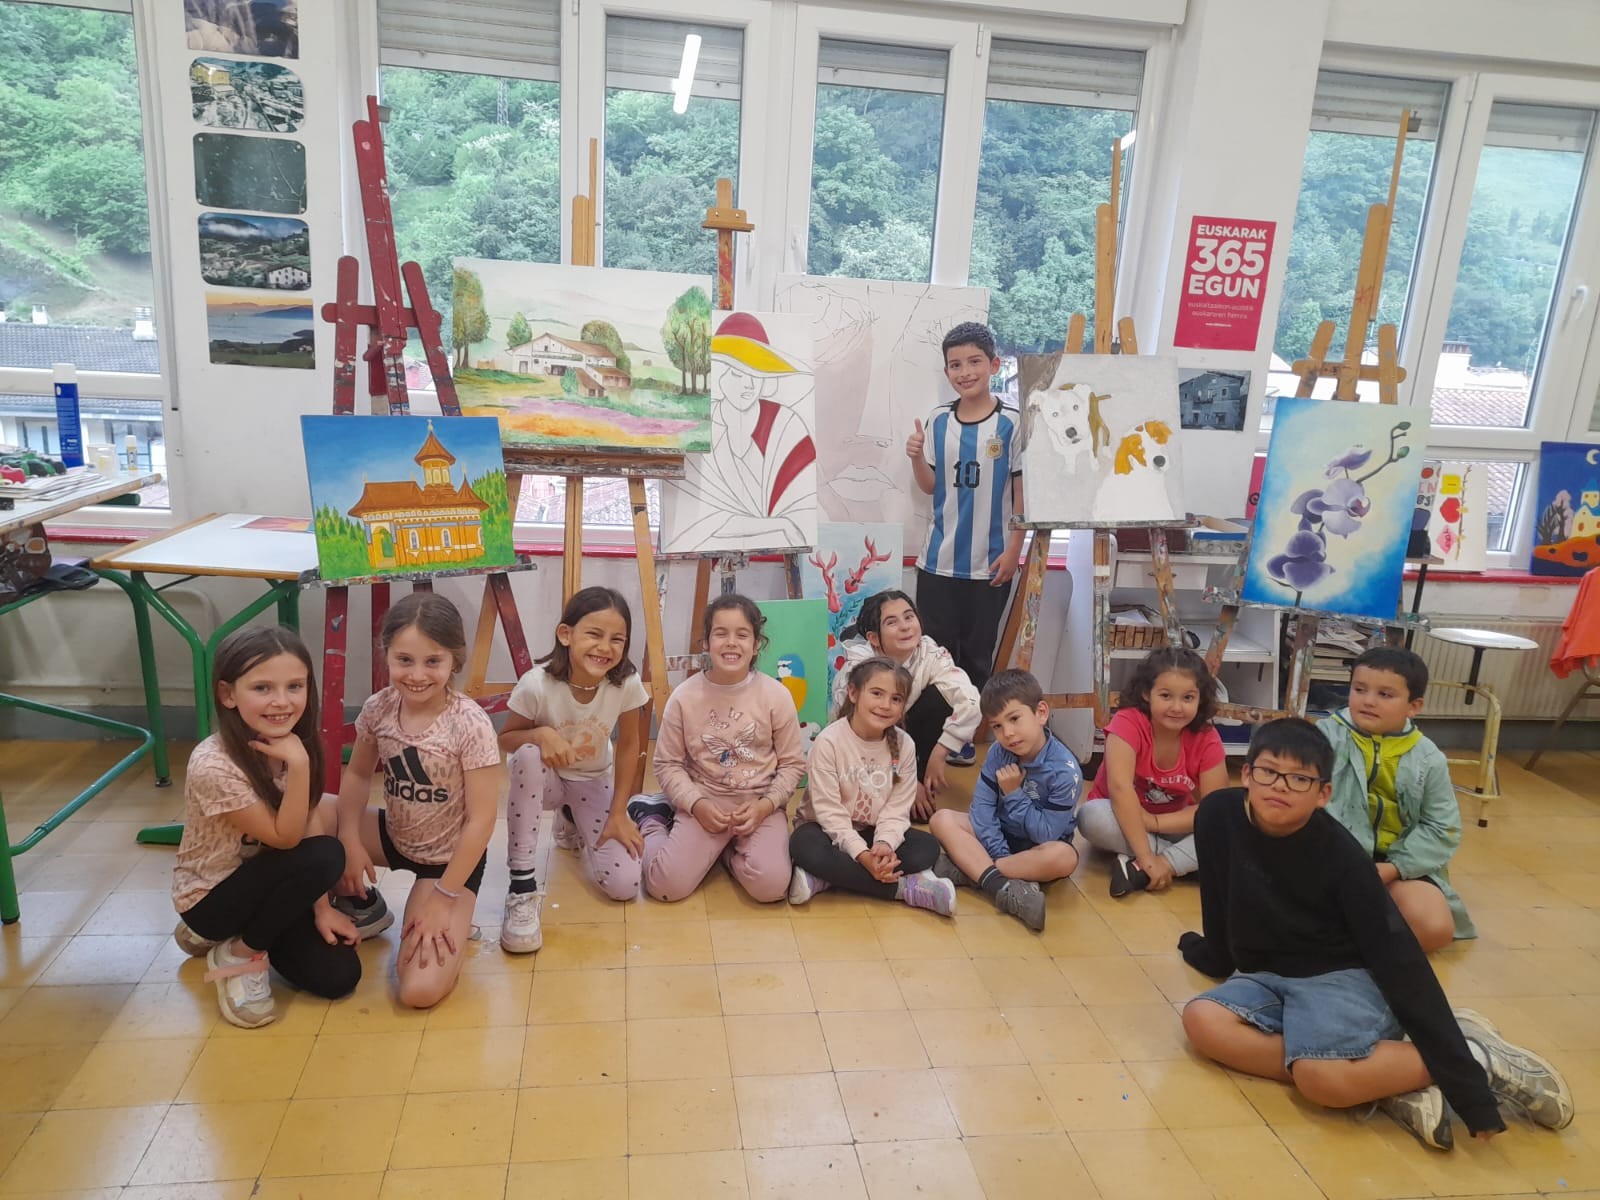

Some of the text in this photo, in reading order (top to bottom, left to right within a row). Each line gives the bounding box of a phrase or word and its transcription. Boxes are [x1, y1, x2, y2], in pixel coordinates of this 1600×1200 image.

[1197, 224, 1267, 239] EUSKARAK
[1191, 238, 1266, 276] 365
[1188, 274, 1260, 299] EGUN
[953, 461, 980, 488] 10
[385, 776, 449, 803] didas
